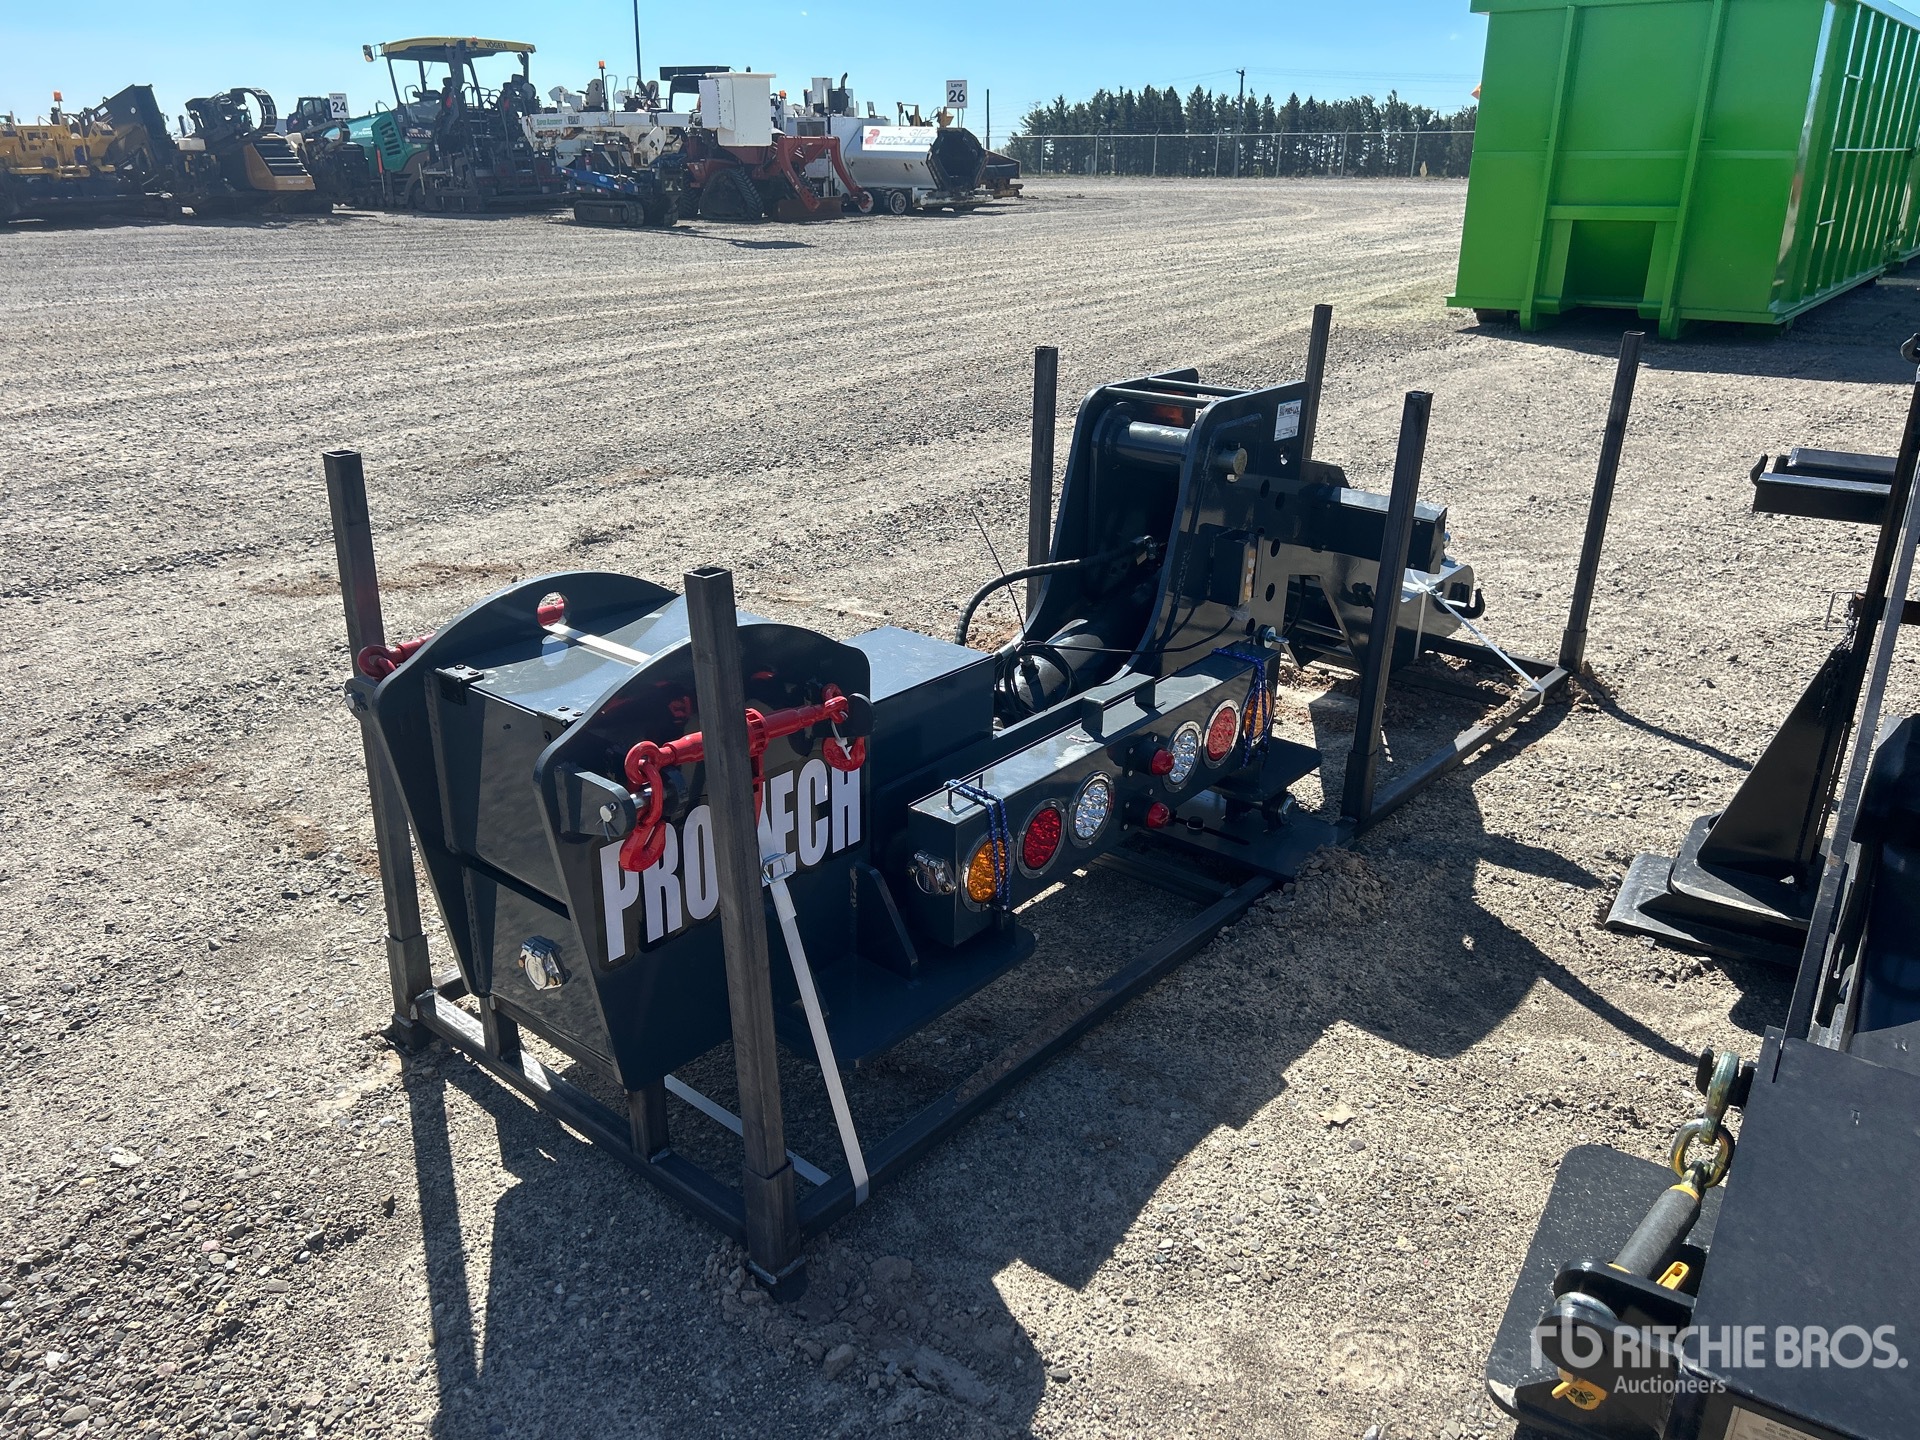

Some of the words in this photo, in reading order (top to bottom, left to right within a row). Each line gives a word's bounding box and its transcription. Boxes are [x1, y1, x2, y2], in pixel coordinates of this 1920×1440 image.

[948, 90, 966, 102] 26
[332, 102, 346, 112] 24
[599, 758, 861, 962] PROECH
